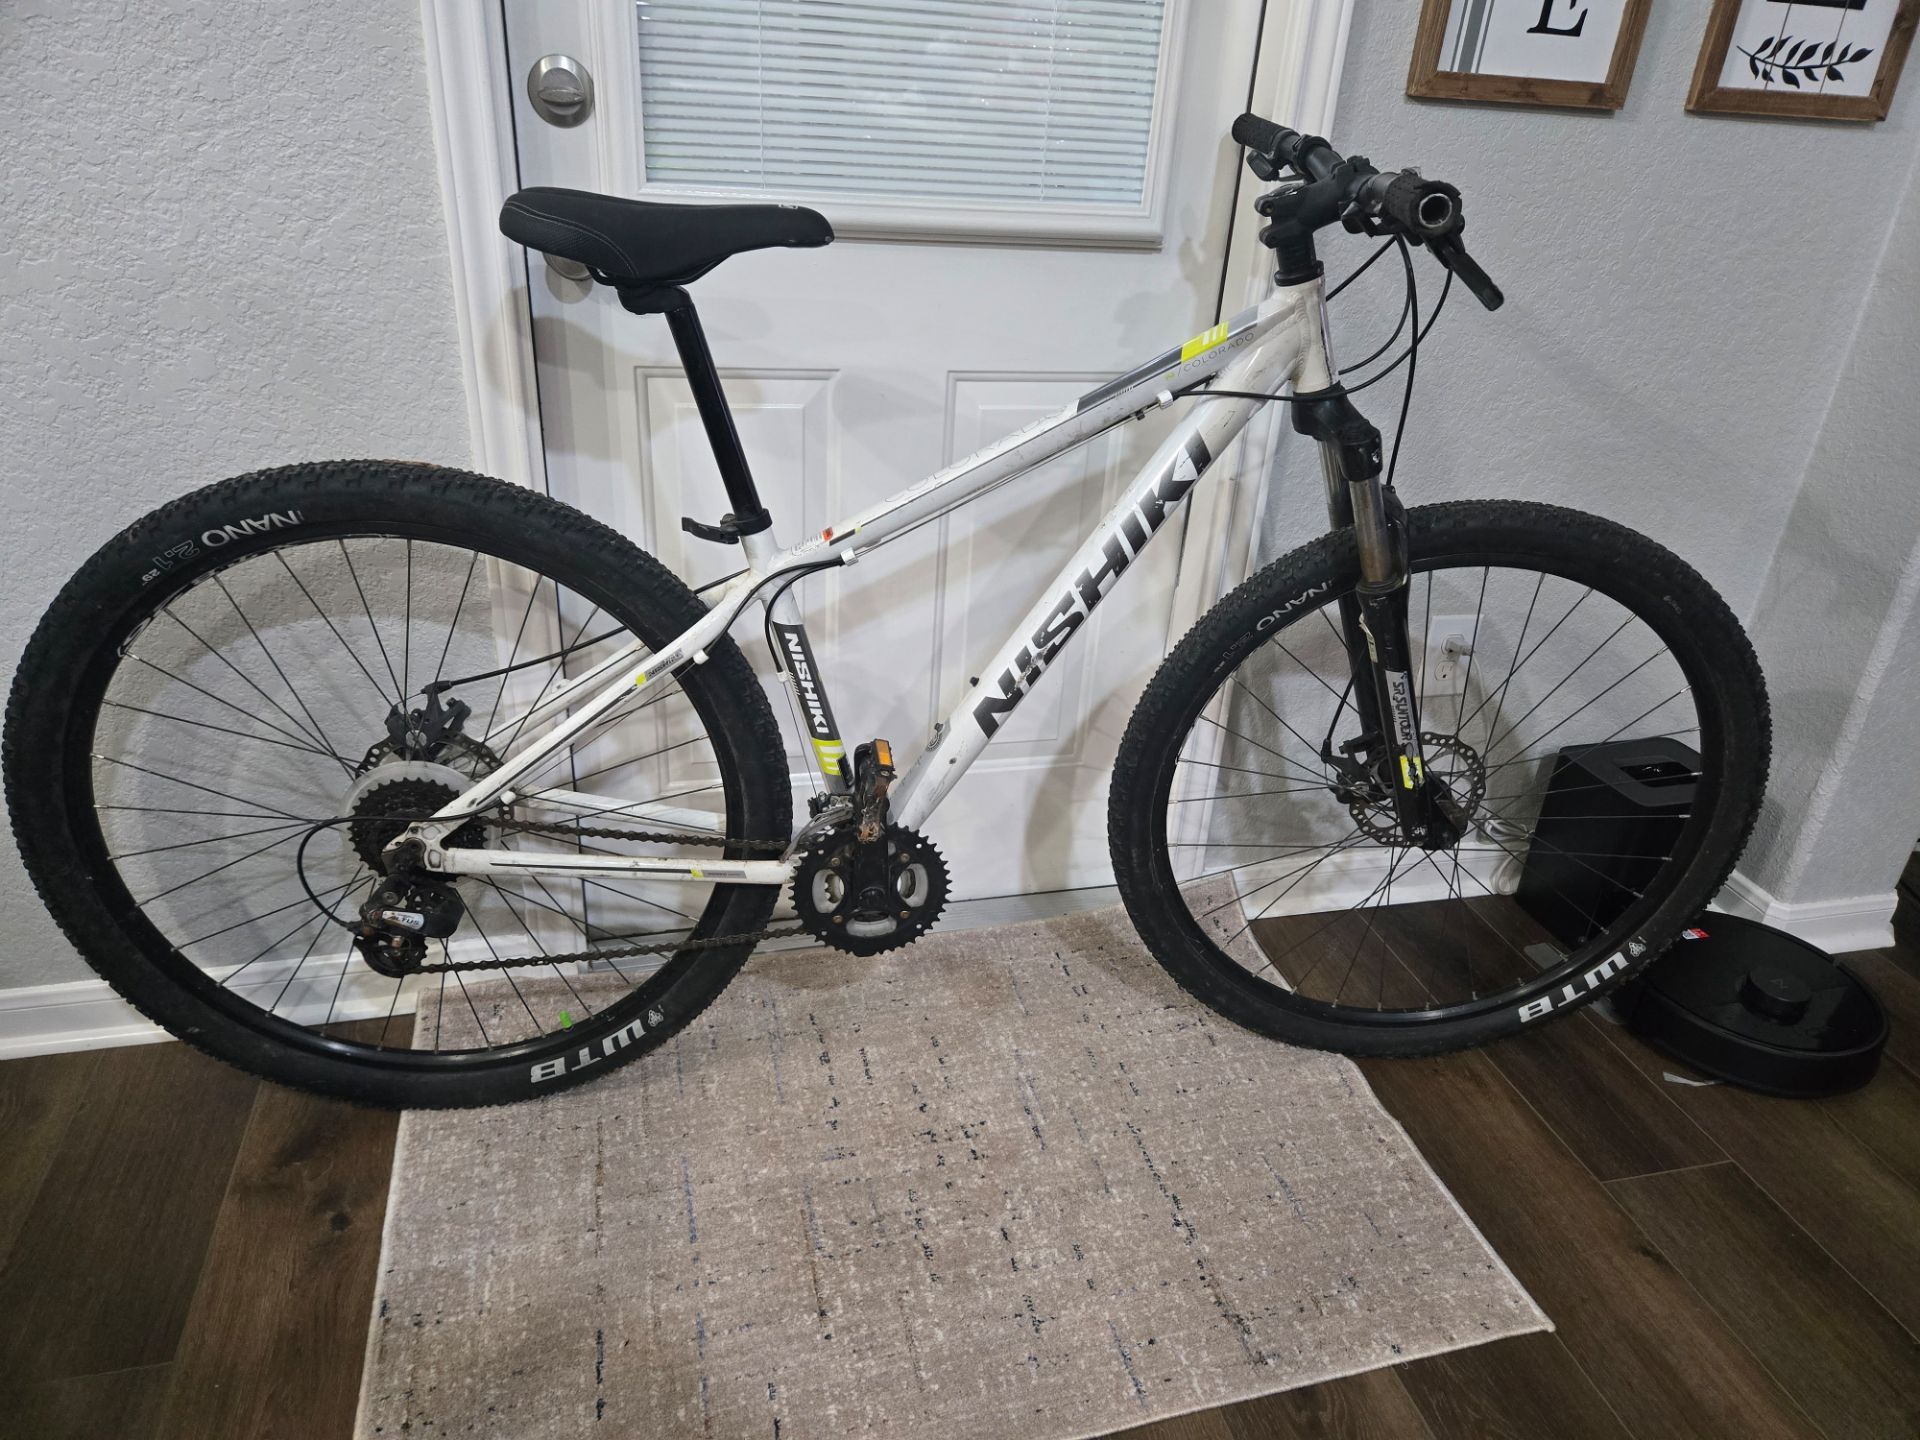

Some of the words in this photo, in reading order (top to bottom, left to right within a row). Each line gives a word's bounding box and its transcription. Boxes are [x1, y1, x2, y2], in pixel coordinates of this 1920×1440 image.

[152, 539, 200, 571] 2.1
[201, 510, 300, 547] NANO
[973, 428, 1212, 739] NISHIKI
[1256, 582, 1328, 631] NANO
[784, 632, 830, 734] NISHIKI
[1518, 951, 1630, 1023] WTB
[531, 1018, 647, 1083] WTB
